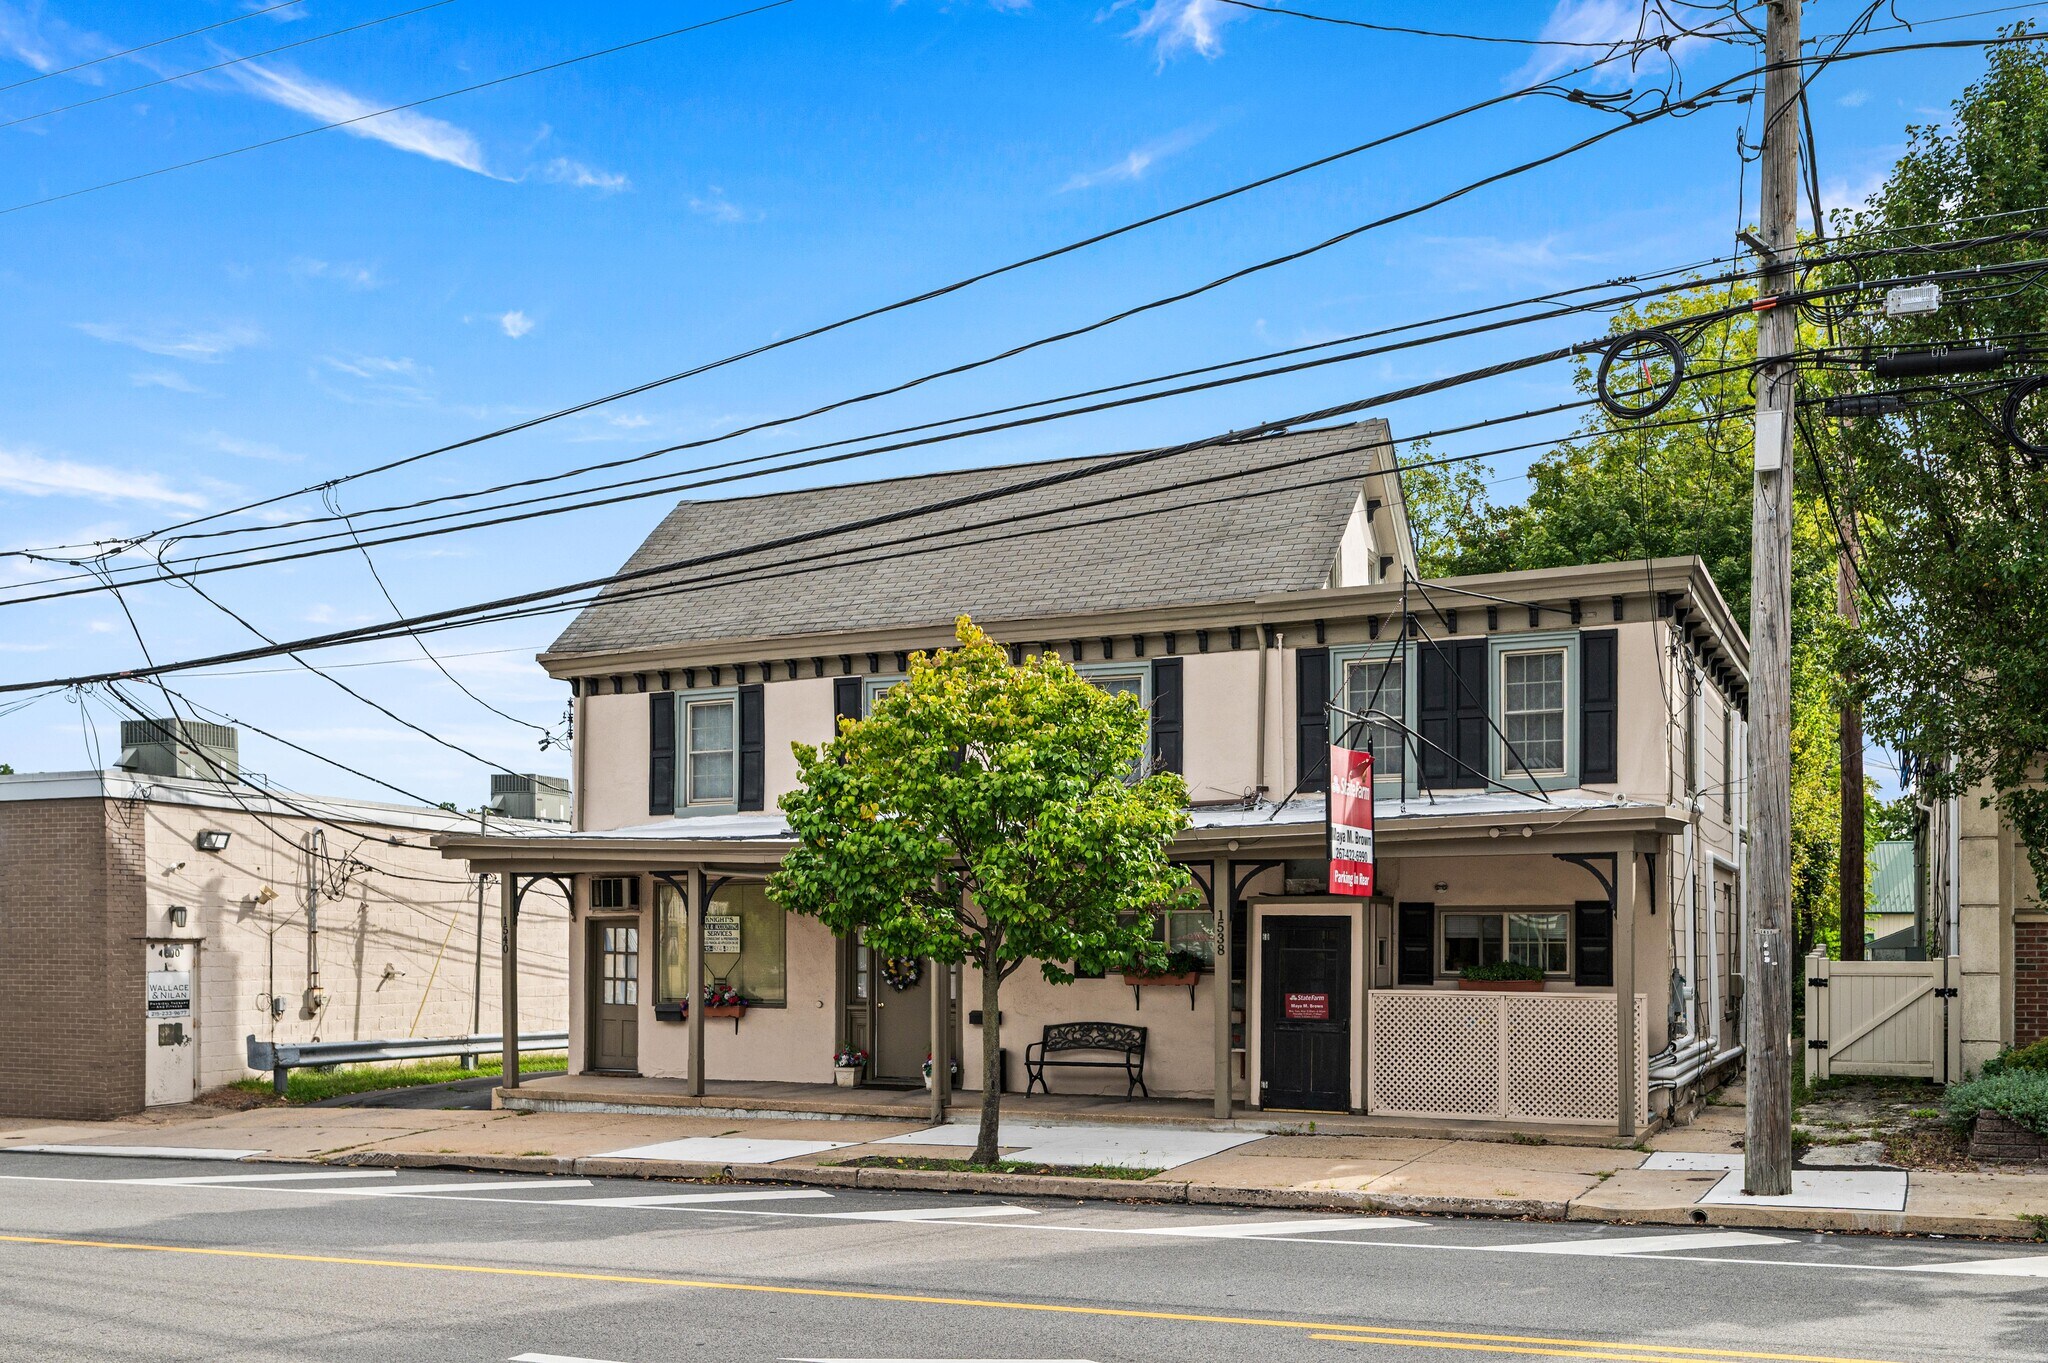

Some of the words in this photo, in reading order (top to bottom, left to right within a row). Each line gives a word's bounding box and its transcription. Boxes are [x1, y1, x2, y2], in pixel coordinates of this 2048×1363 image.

[1355, 831, 1371, 846] Brown
[1334, 869, 1353, 887] Parking
[1359, 873, 1370, 885] Rear
[1217, 910, 1225, 956] 1538
